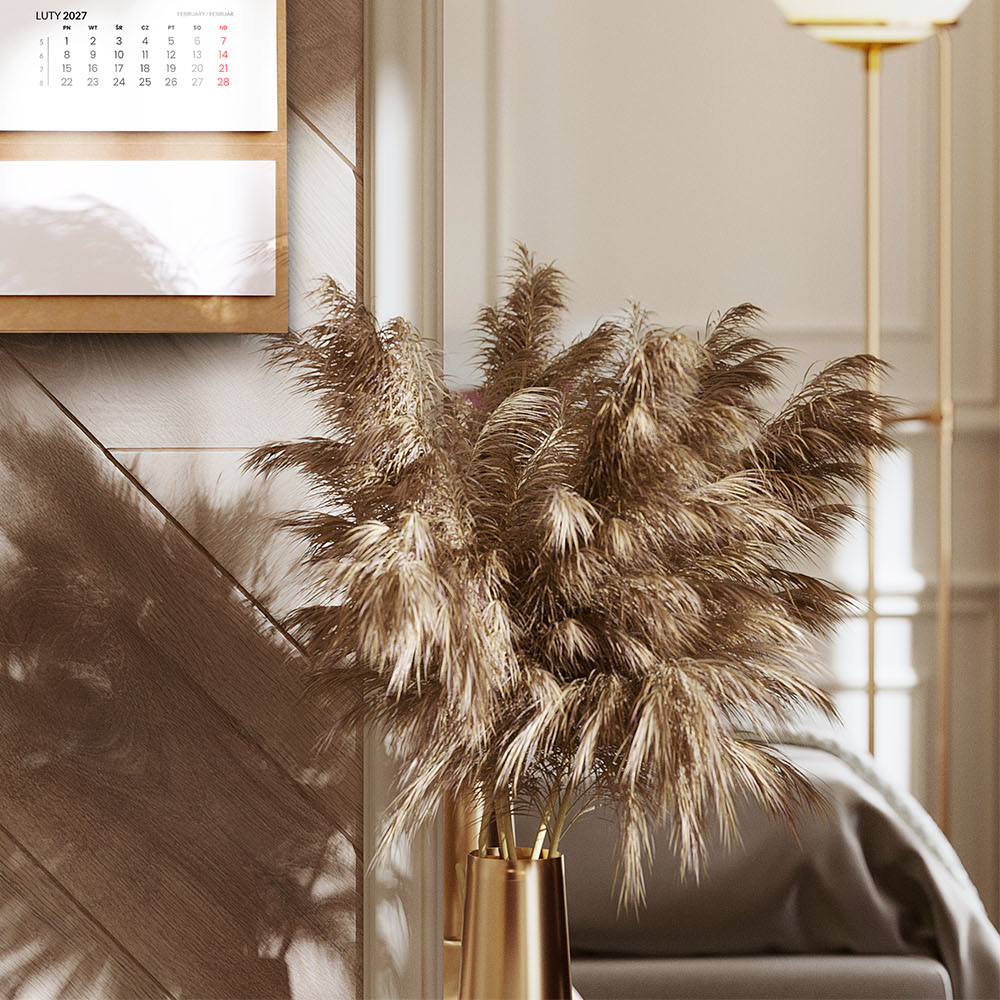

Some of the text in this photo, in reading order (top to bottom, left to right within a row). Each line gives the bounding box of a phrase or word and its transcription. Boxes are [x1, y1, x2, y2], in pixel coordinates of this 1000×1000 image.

[36, 12, 87, 20] LUTY 2027
[65, 37, 226, 45] 1 2 3 4 5 7
[64, 50, 228, 59] 8 9 10 11 12 14
[63, 64, 227, 73] 15 16 17 18 19 21
[61, 78, 229, 86] 22 23 24 25 26 28
